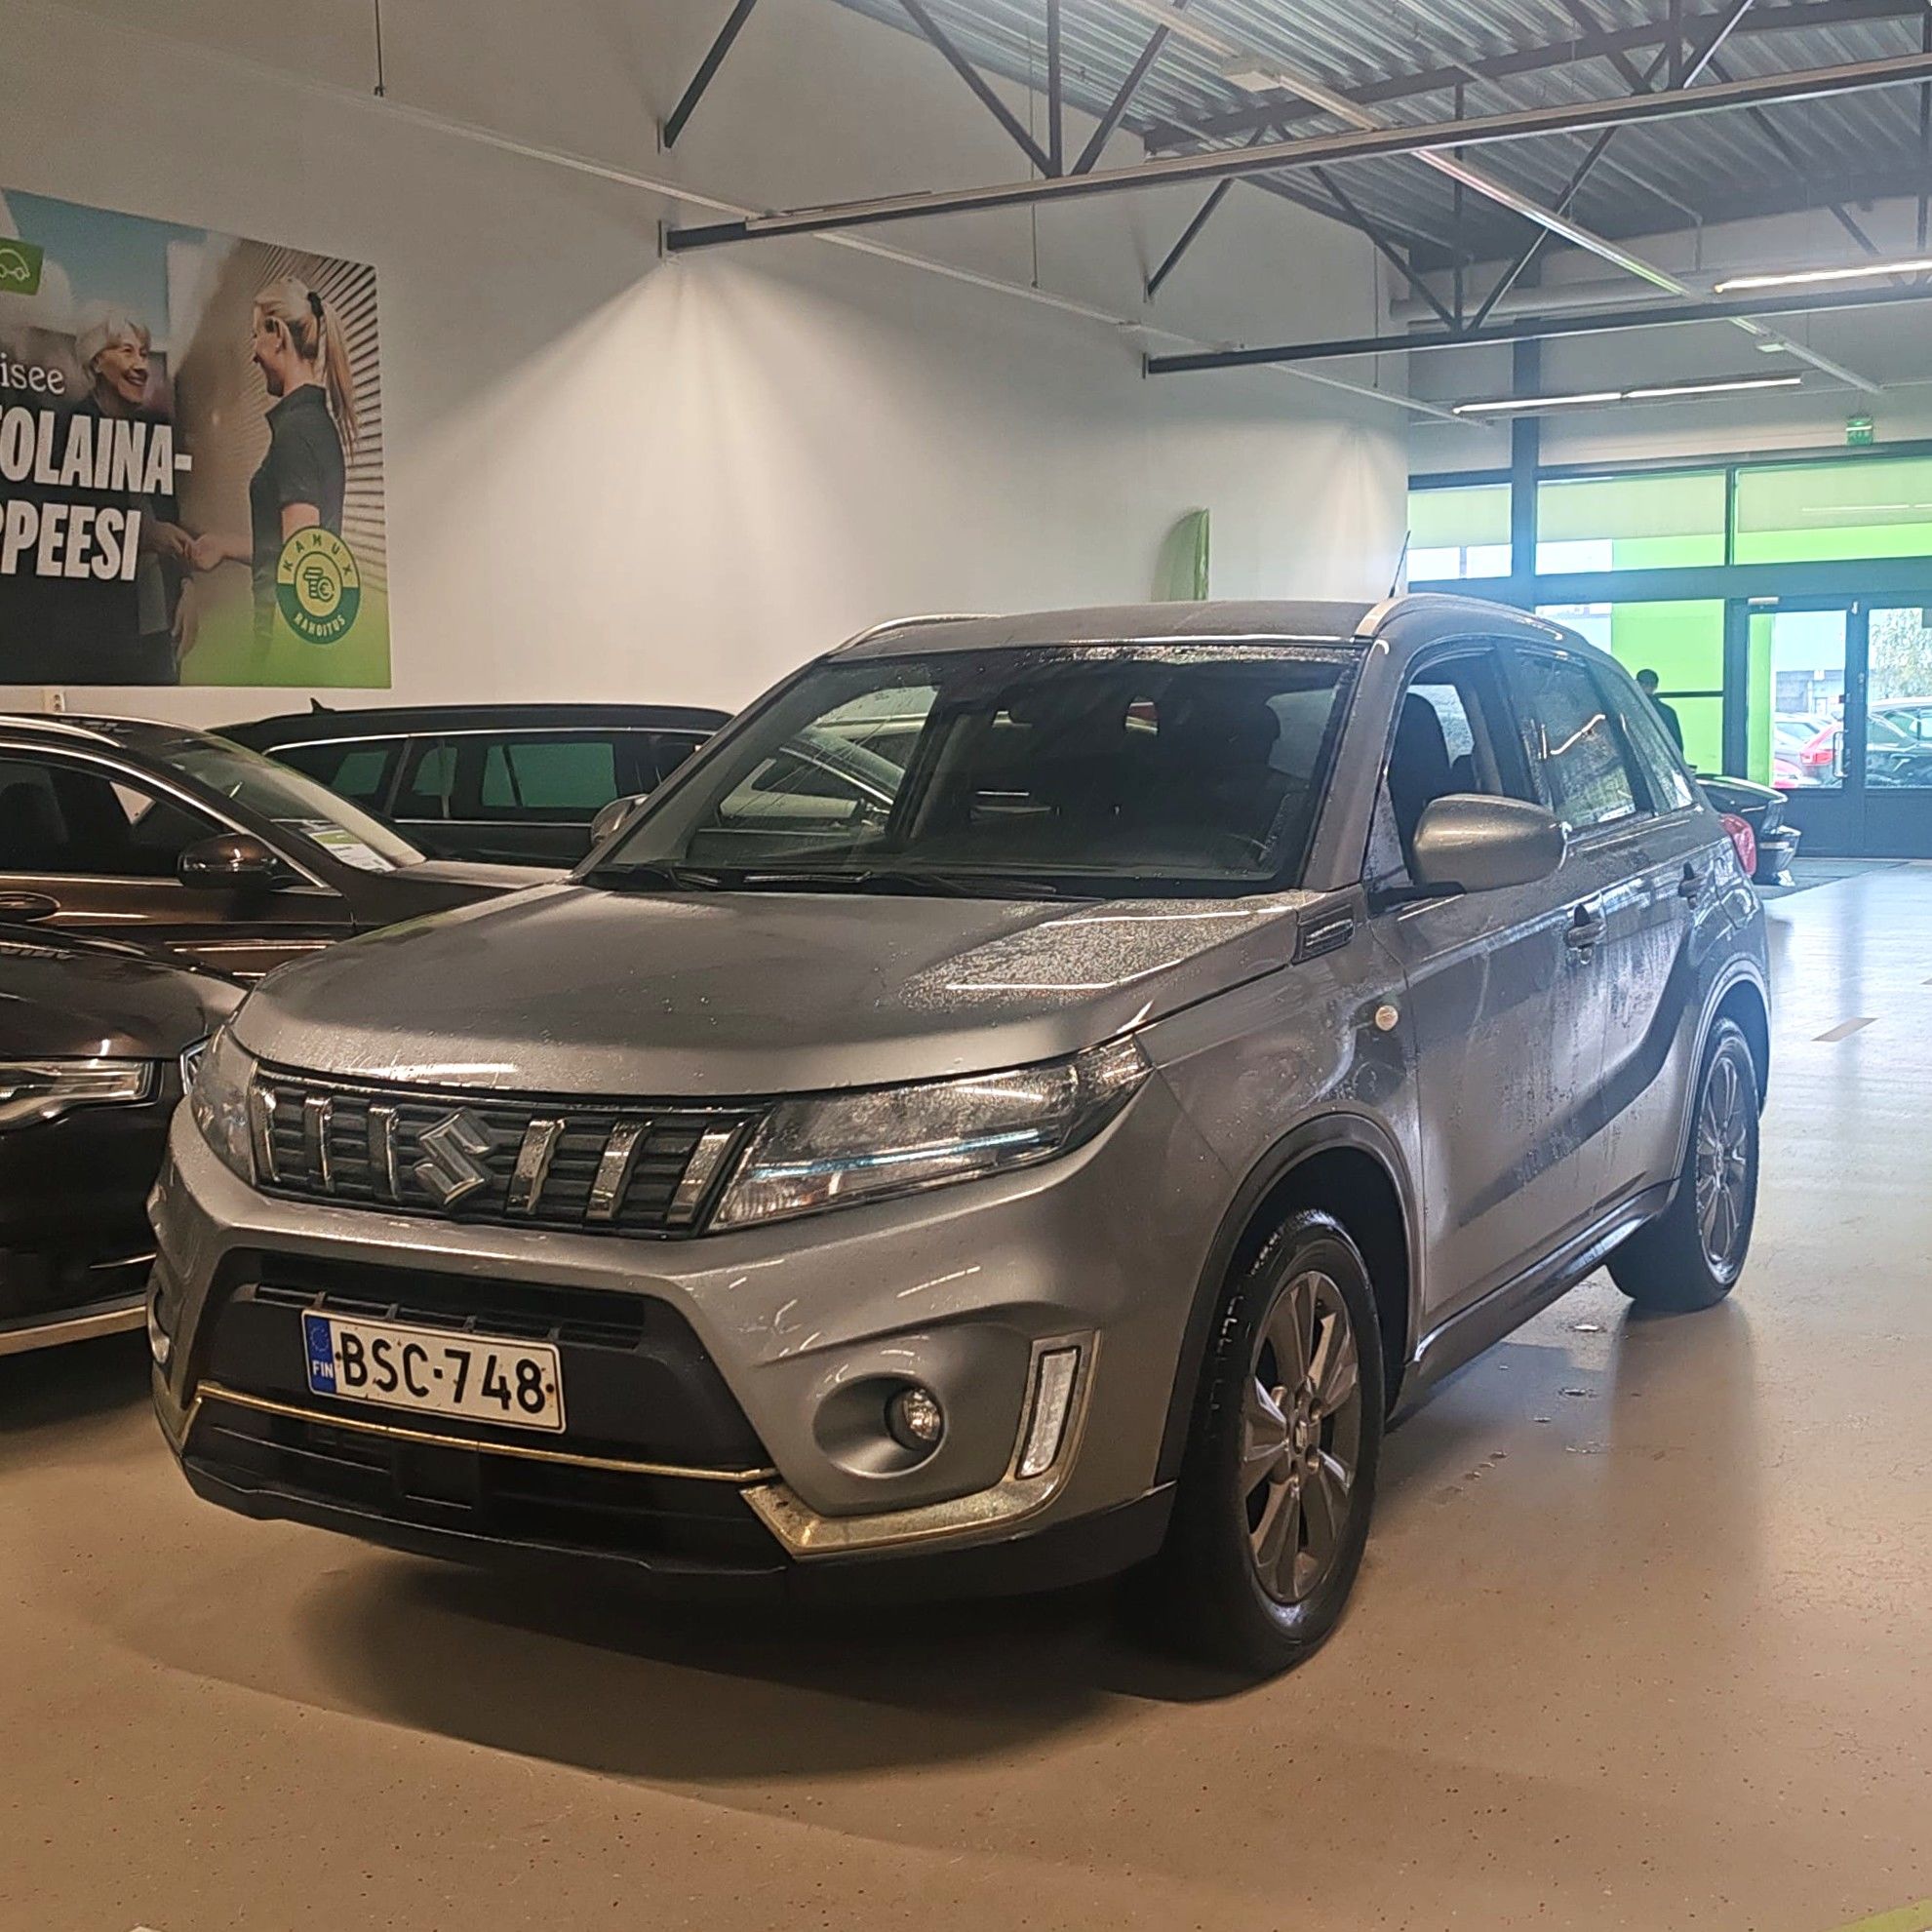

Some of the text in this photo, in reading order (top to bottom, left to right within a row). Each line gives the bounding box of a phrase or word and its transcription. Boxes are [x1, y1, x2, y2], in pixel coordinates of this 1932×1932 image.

[0, 404, 192, 495] OLAINA-
[0, 499, 141, 581] PEESI
[312, 1360, 334, 1379] FIN
[340, 1331, 546, 1414] BSC-748
